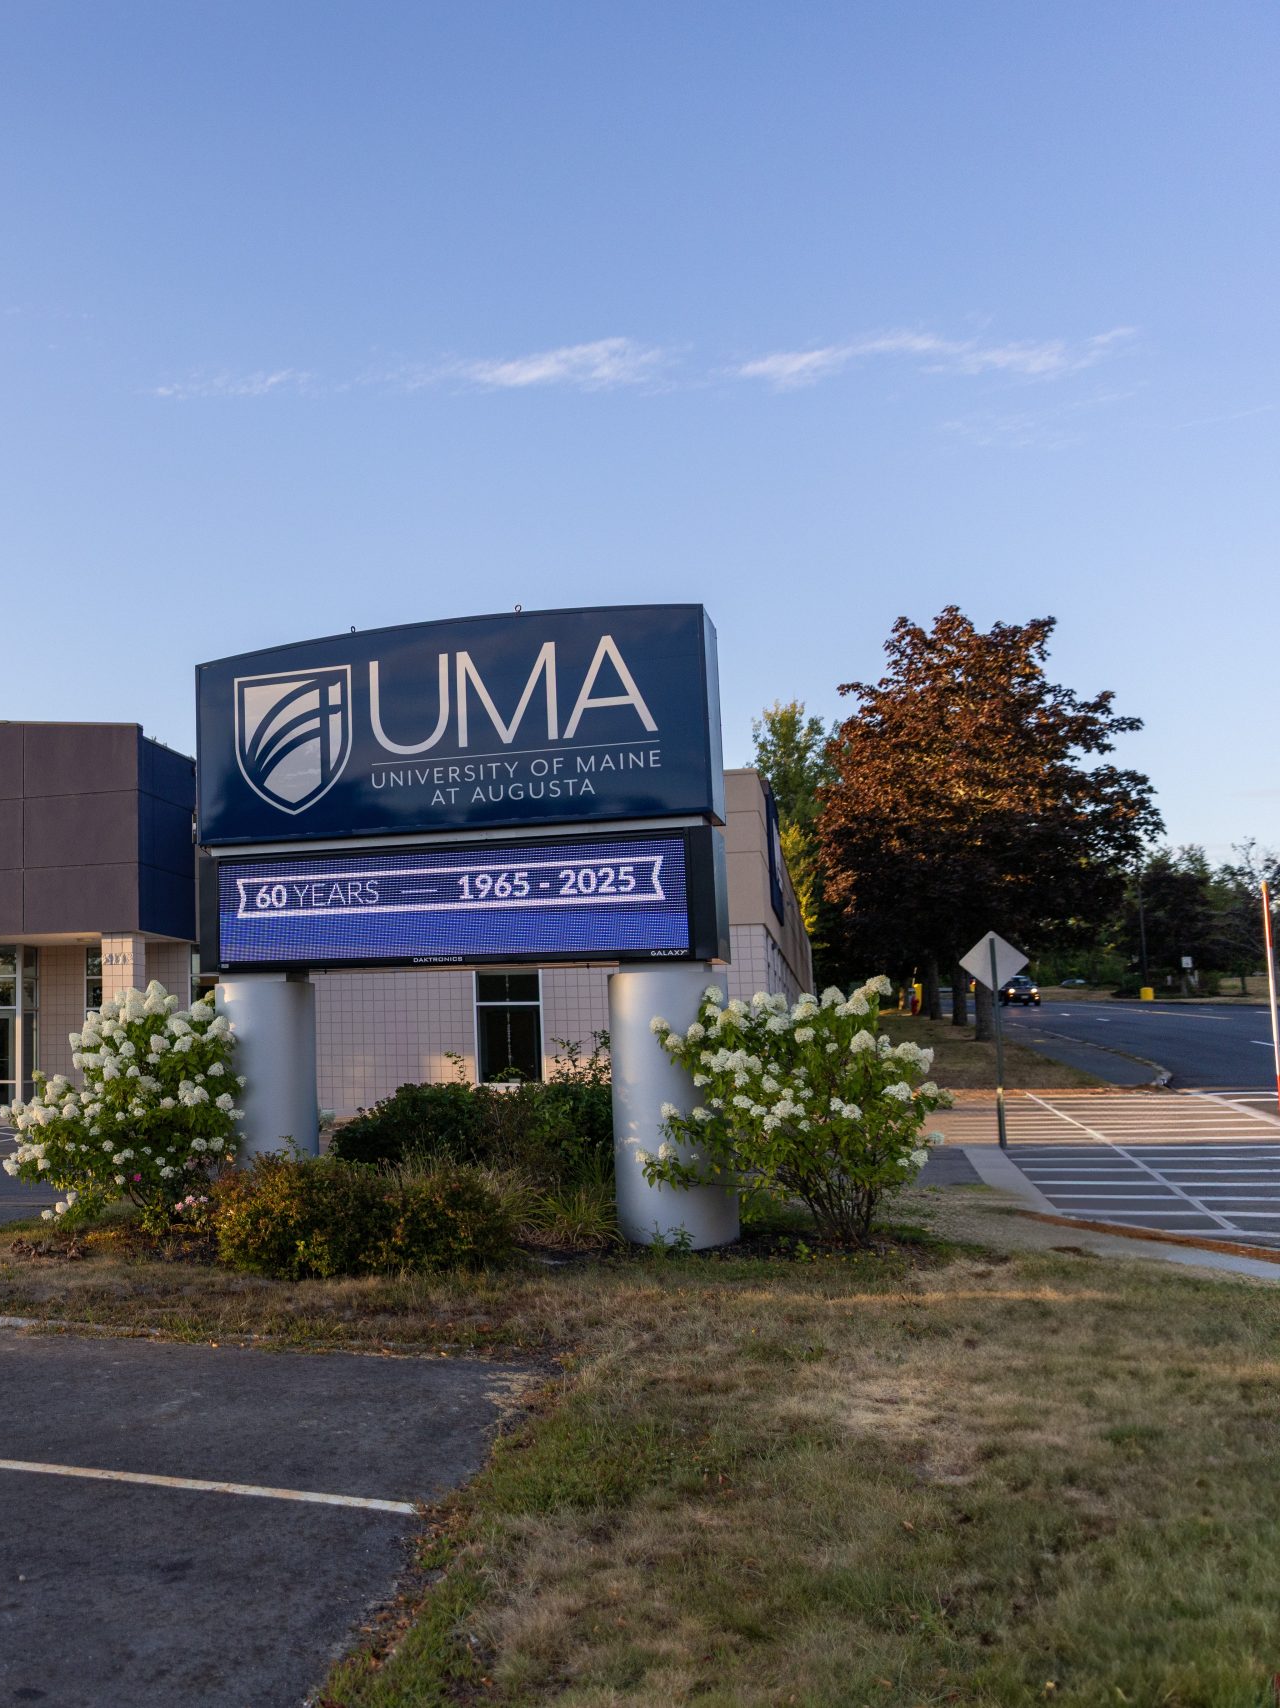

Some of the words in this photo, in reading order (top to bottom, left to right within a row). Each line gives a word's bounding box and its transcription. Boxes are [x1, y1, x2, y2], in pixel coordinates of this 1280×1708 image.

[368, 634, 659, 755] UMA
[371, 761, 519, 789] UNIVERSITY
[529, 757, 564, 777] OF
[576, 750, 662, 773] MAINE
[431, 787, 460, 806] AT
[471, 778, 596, 803] AUGUSTA
[255, 883, 288, 909] 60
[293, 880, 380, 907] YEARS
[458, 872, 530, 900] 1965
[559, 866, 636, 896] 2025
